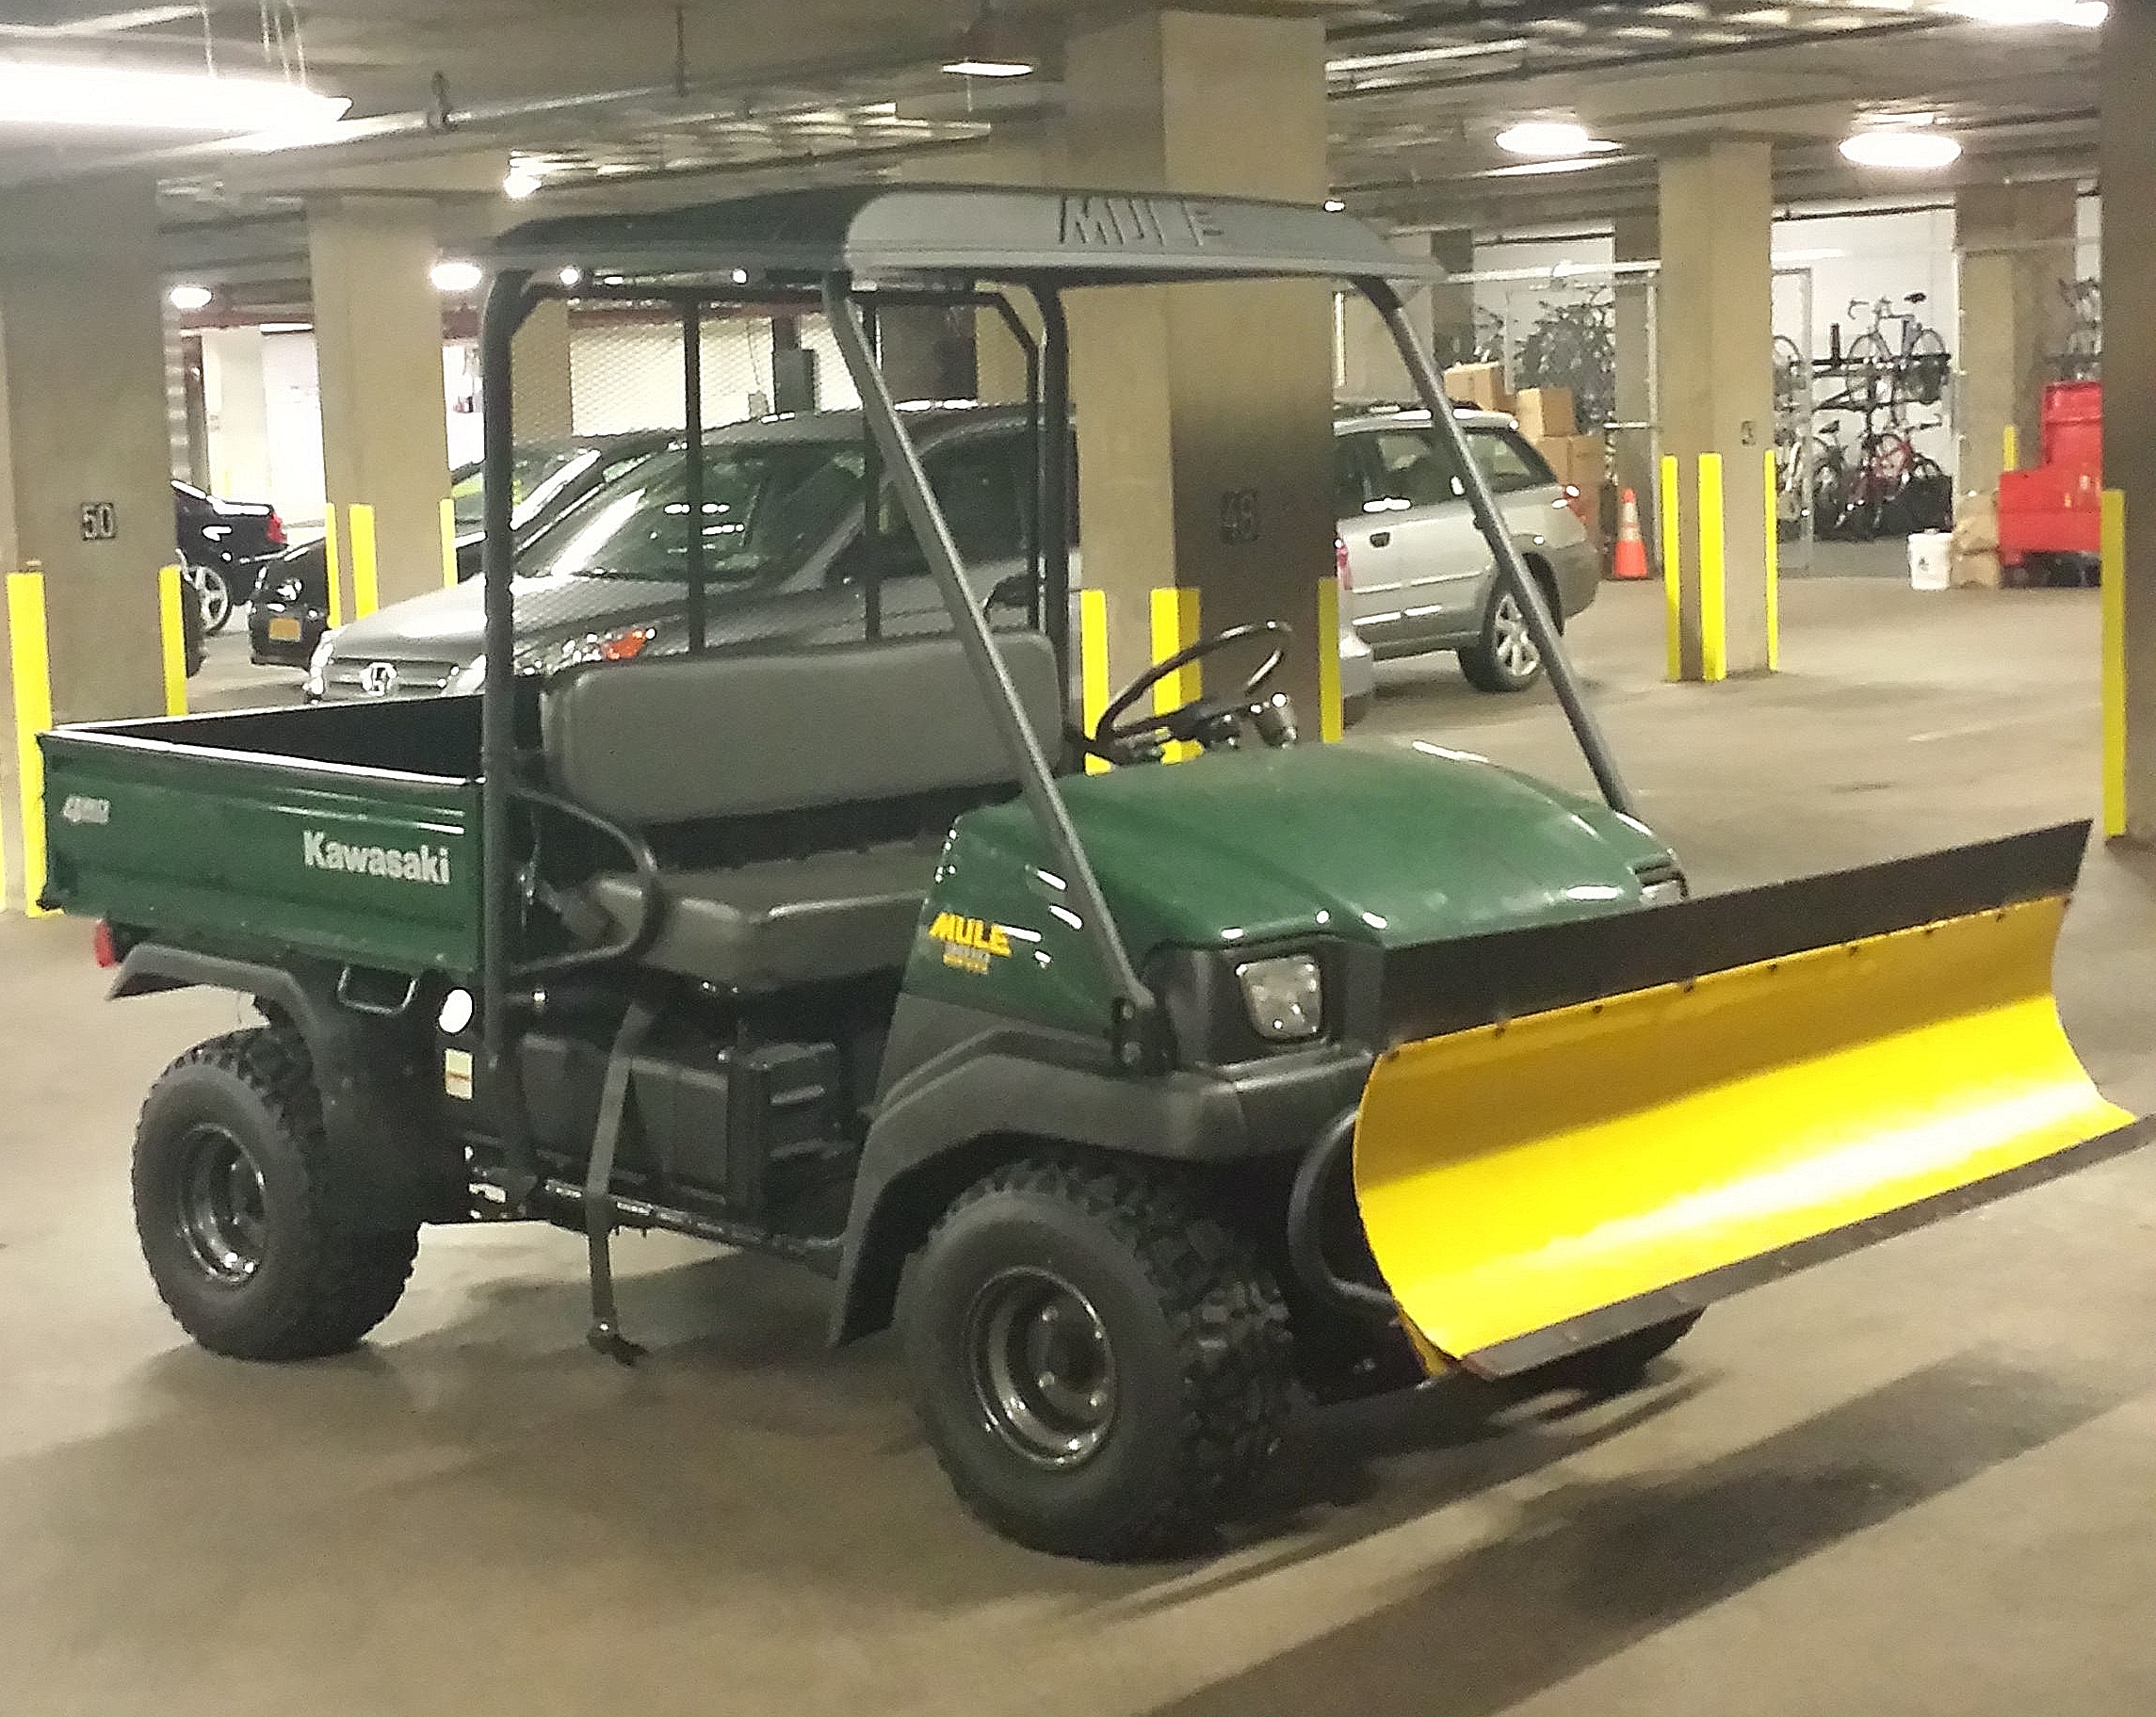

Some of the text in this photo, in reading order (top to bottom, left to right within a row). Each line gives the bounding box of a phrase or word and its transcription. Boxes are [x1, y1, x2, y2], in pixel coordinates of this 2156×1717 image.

[1058, 192, 1224, 246] MULE
[83, 504, 113, 538] 50
[302, 829, 451, 883] Kawasaki
[929, 911, 1012, 956] MULE
